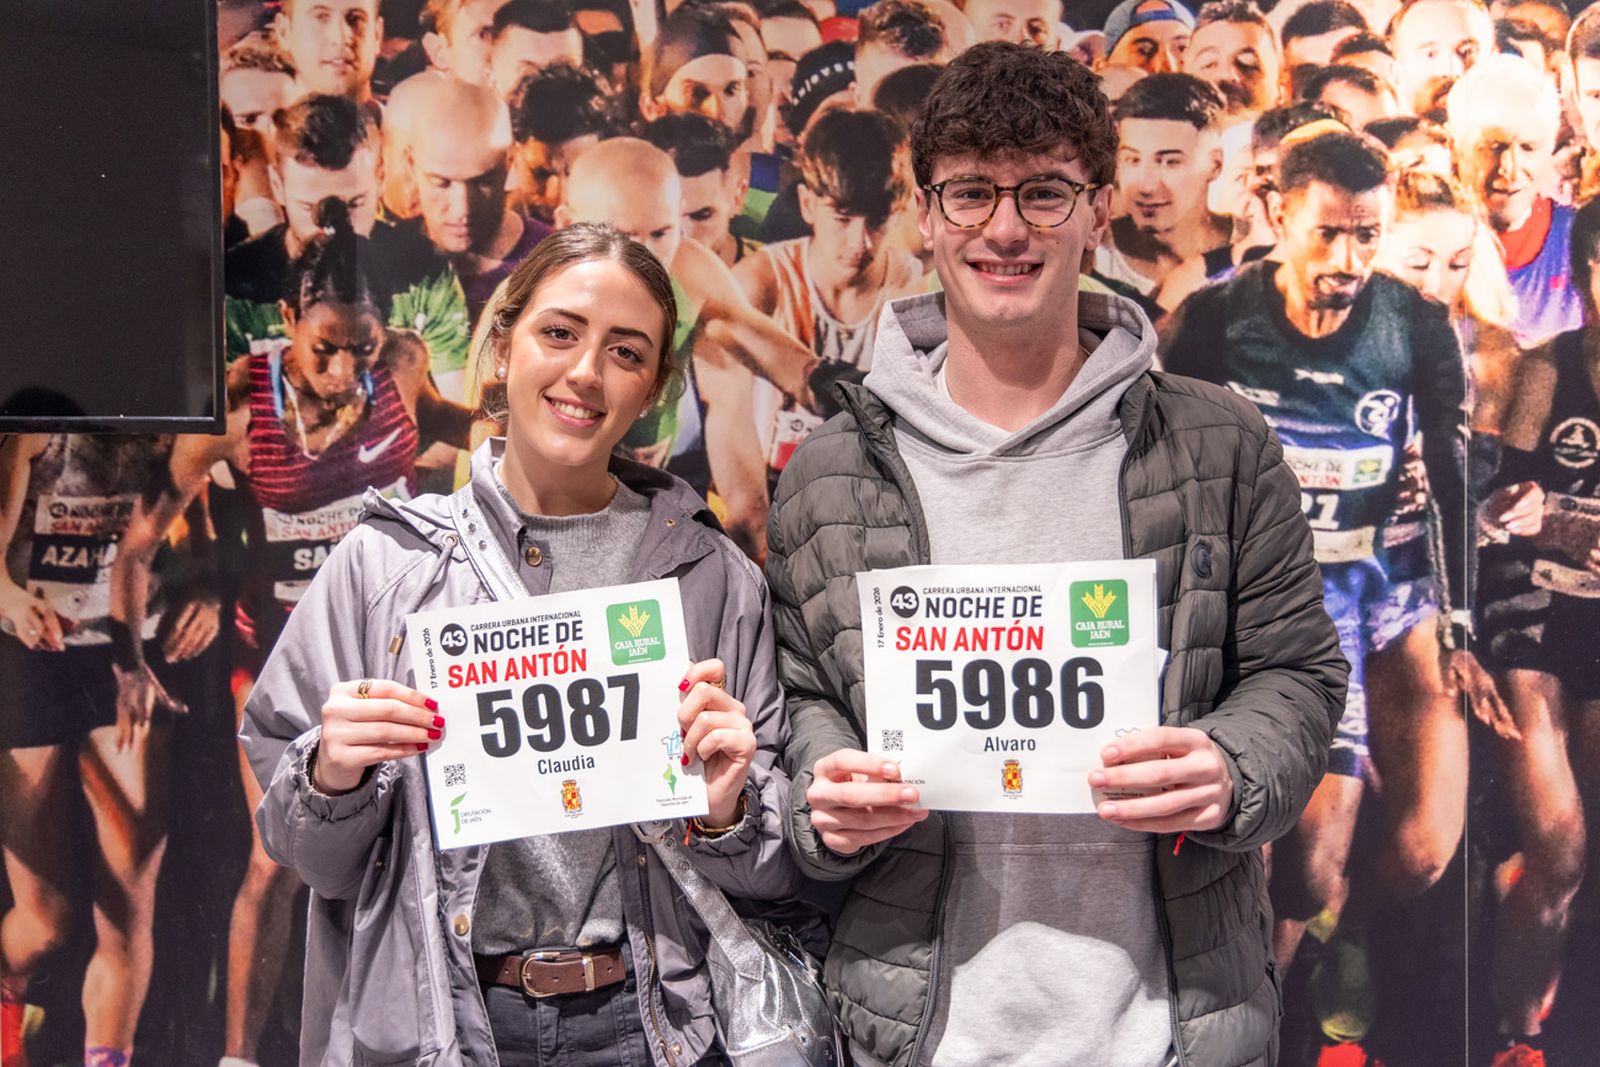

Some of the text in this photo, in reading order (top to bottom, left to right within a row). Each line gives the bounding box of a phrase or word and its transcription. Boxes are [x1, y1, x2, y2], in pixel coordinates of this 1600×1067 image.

[296, 511, 346, 525] NOCHE
[281, 525, 312, 538] SAN
[293, 544, 338, 571] SA
[872, 587, 880, 605] 2026
[922, 585, 1042, 595] CARRERA URBANA INTERNACIONAL
[874, 606, 883, 616] de
[891, 592, 918, 610] 43
[925, 595, 1043, 619] NOCHE DE
[470, 610, 582, 632] CARRERA URBANA INTERNACIONAL
[1075, 620, 1125, 631] CAJA RURAL
[441, 629, 467, 648] 43
[473, 619, 584, 655] NOCHE DE
[634, 636, 661, 648] RURAL
[895, 619, 1044, 652] SAN ANTÓN
[422, 628, 439, 689] 17 Enero de 2026
[447, 643, 588, 689] SAN ANTÓN
[915, 656, 1105, 731] 5986
[476, 672, 641, 759] 5987
[983, 735, 1037, 752] Alvaro
[537, 753, 596, 775] Claudia
